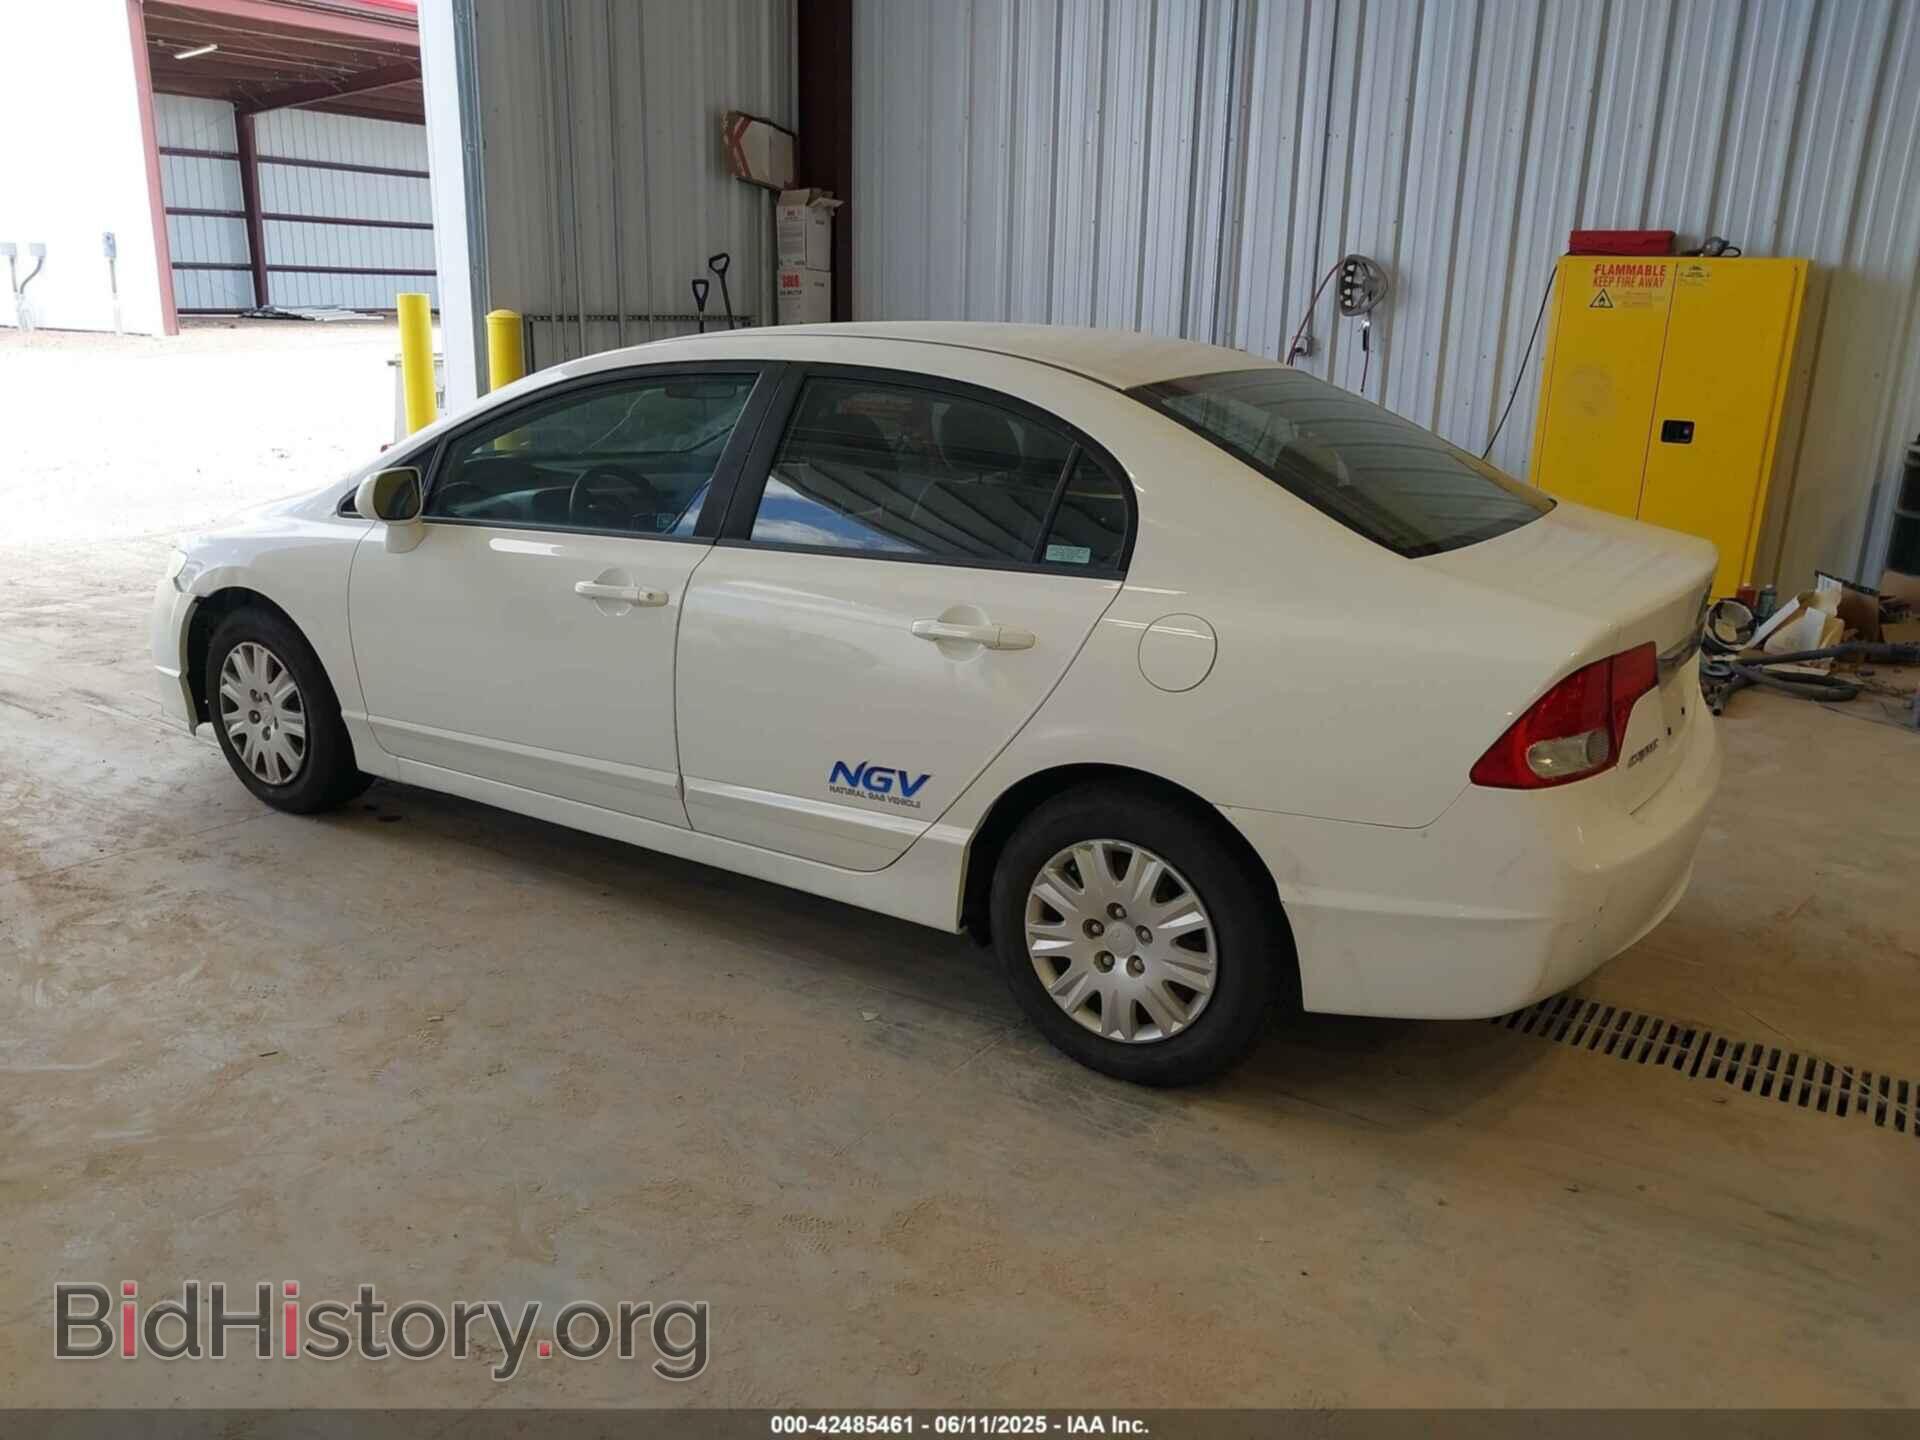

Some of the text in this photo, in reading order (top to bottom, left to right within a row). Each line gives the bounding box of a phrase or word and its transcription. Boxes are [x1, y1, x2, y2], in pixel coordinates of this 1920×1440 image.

[1594, 264, 1667, 276] FLAMMABLE
[1592, 276, 1665, 288] KEEP FIRE AWAY
[829, 760, 932, 798] NGV
[829, 785, 921, 808] NATURAL GAS VEHICLE
